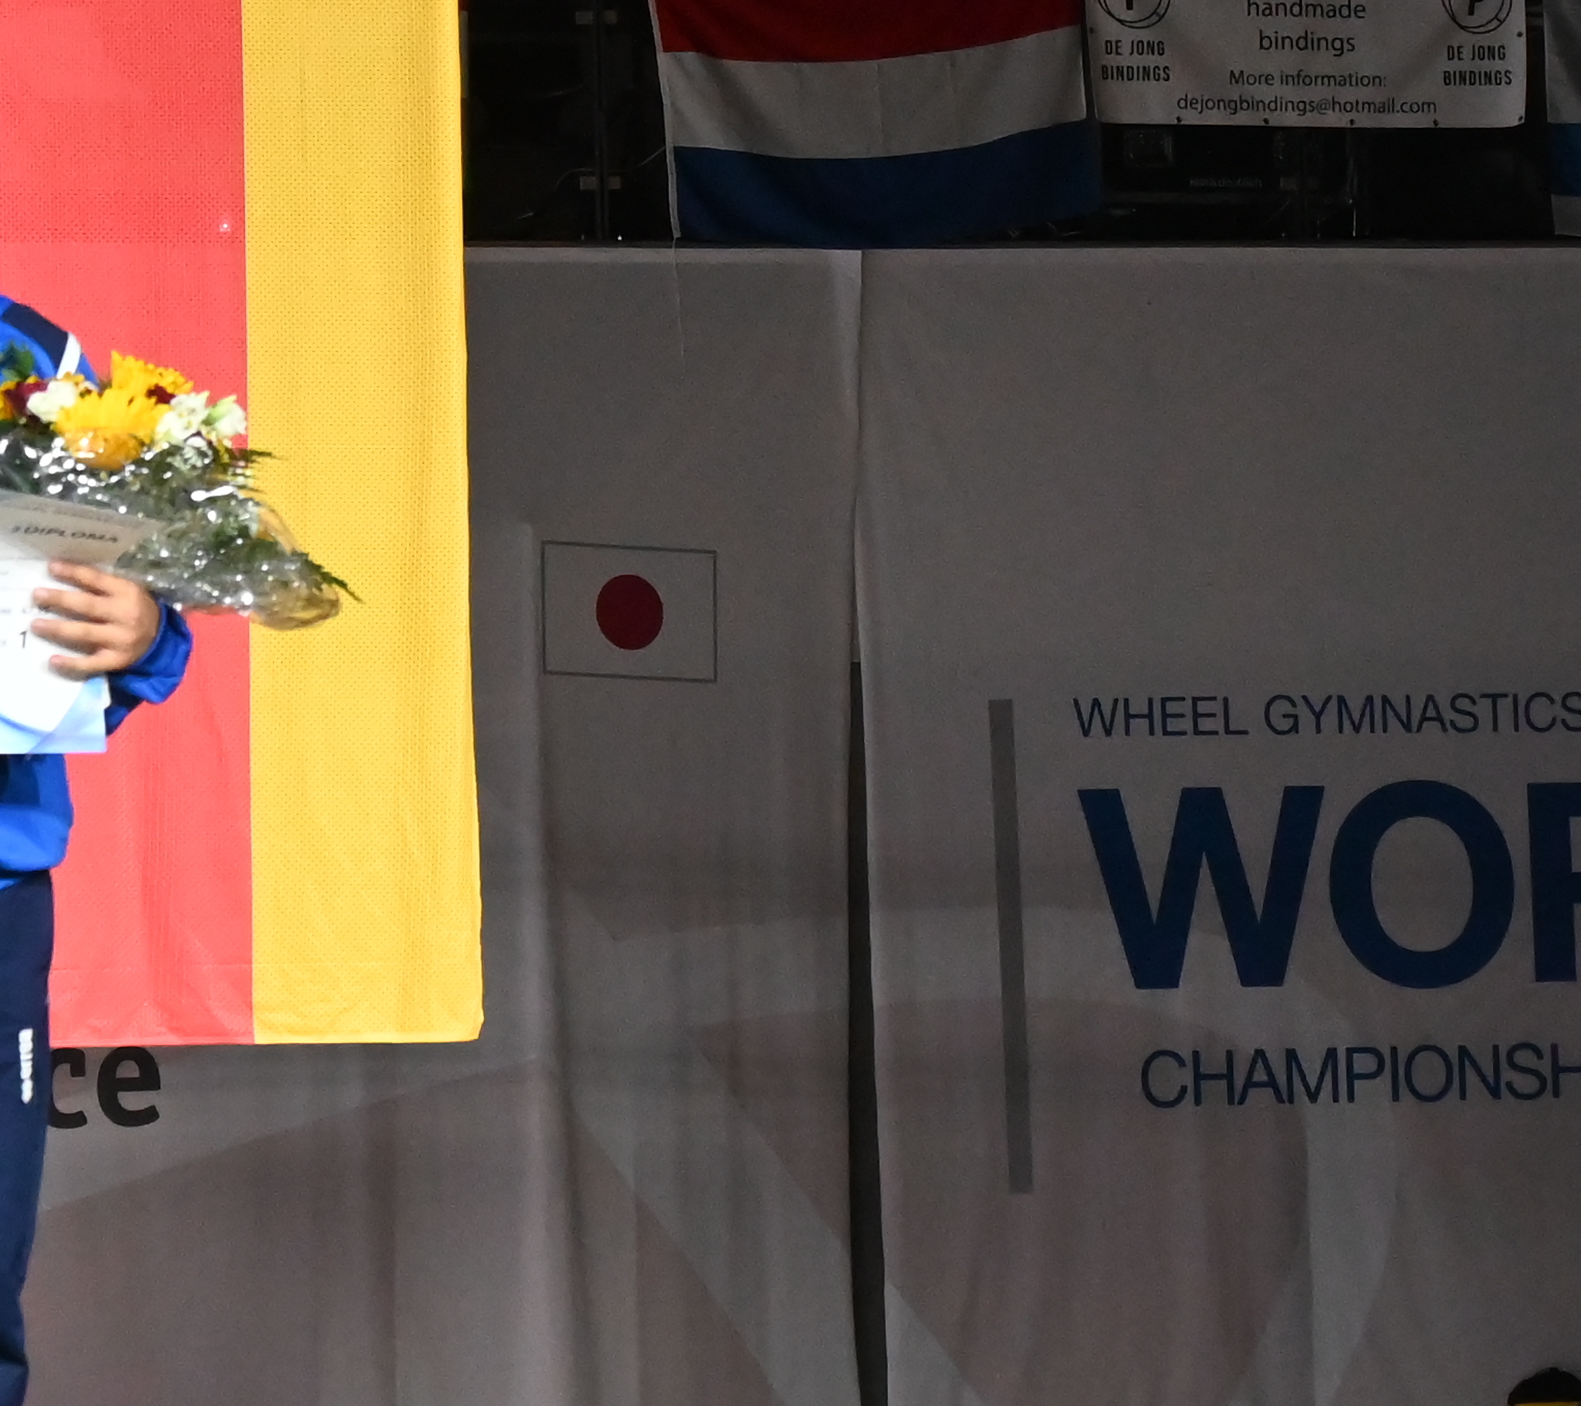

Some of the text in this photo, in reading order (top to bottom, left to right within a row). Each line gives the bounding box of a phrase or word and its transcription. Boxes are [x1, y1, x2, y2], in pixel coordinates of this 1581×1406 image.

[1104, 39, 1166, 57] DE JONG
[1258, 29, 1357, 57] bindings
[1446, 44, 1507, 61] DE JONG
[1100, 64, 1172, 83] BINDINGS
[1228, 69, 1388, 89] More information:
[1442, 68, 1514, 87] BINDINGS
[1176, 92, 1438, 117] dejongbindings@hotmail.com
[18, 629, 29, 649] 1
[1073, 696, 1249, 738] WHEEL
